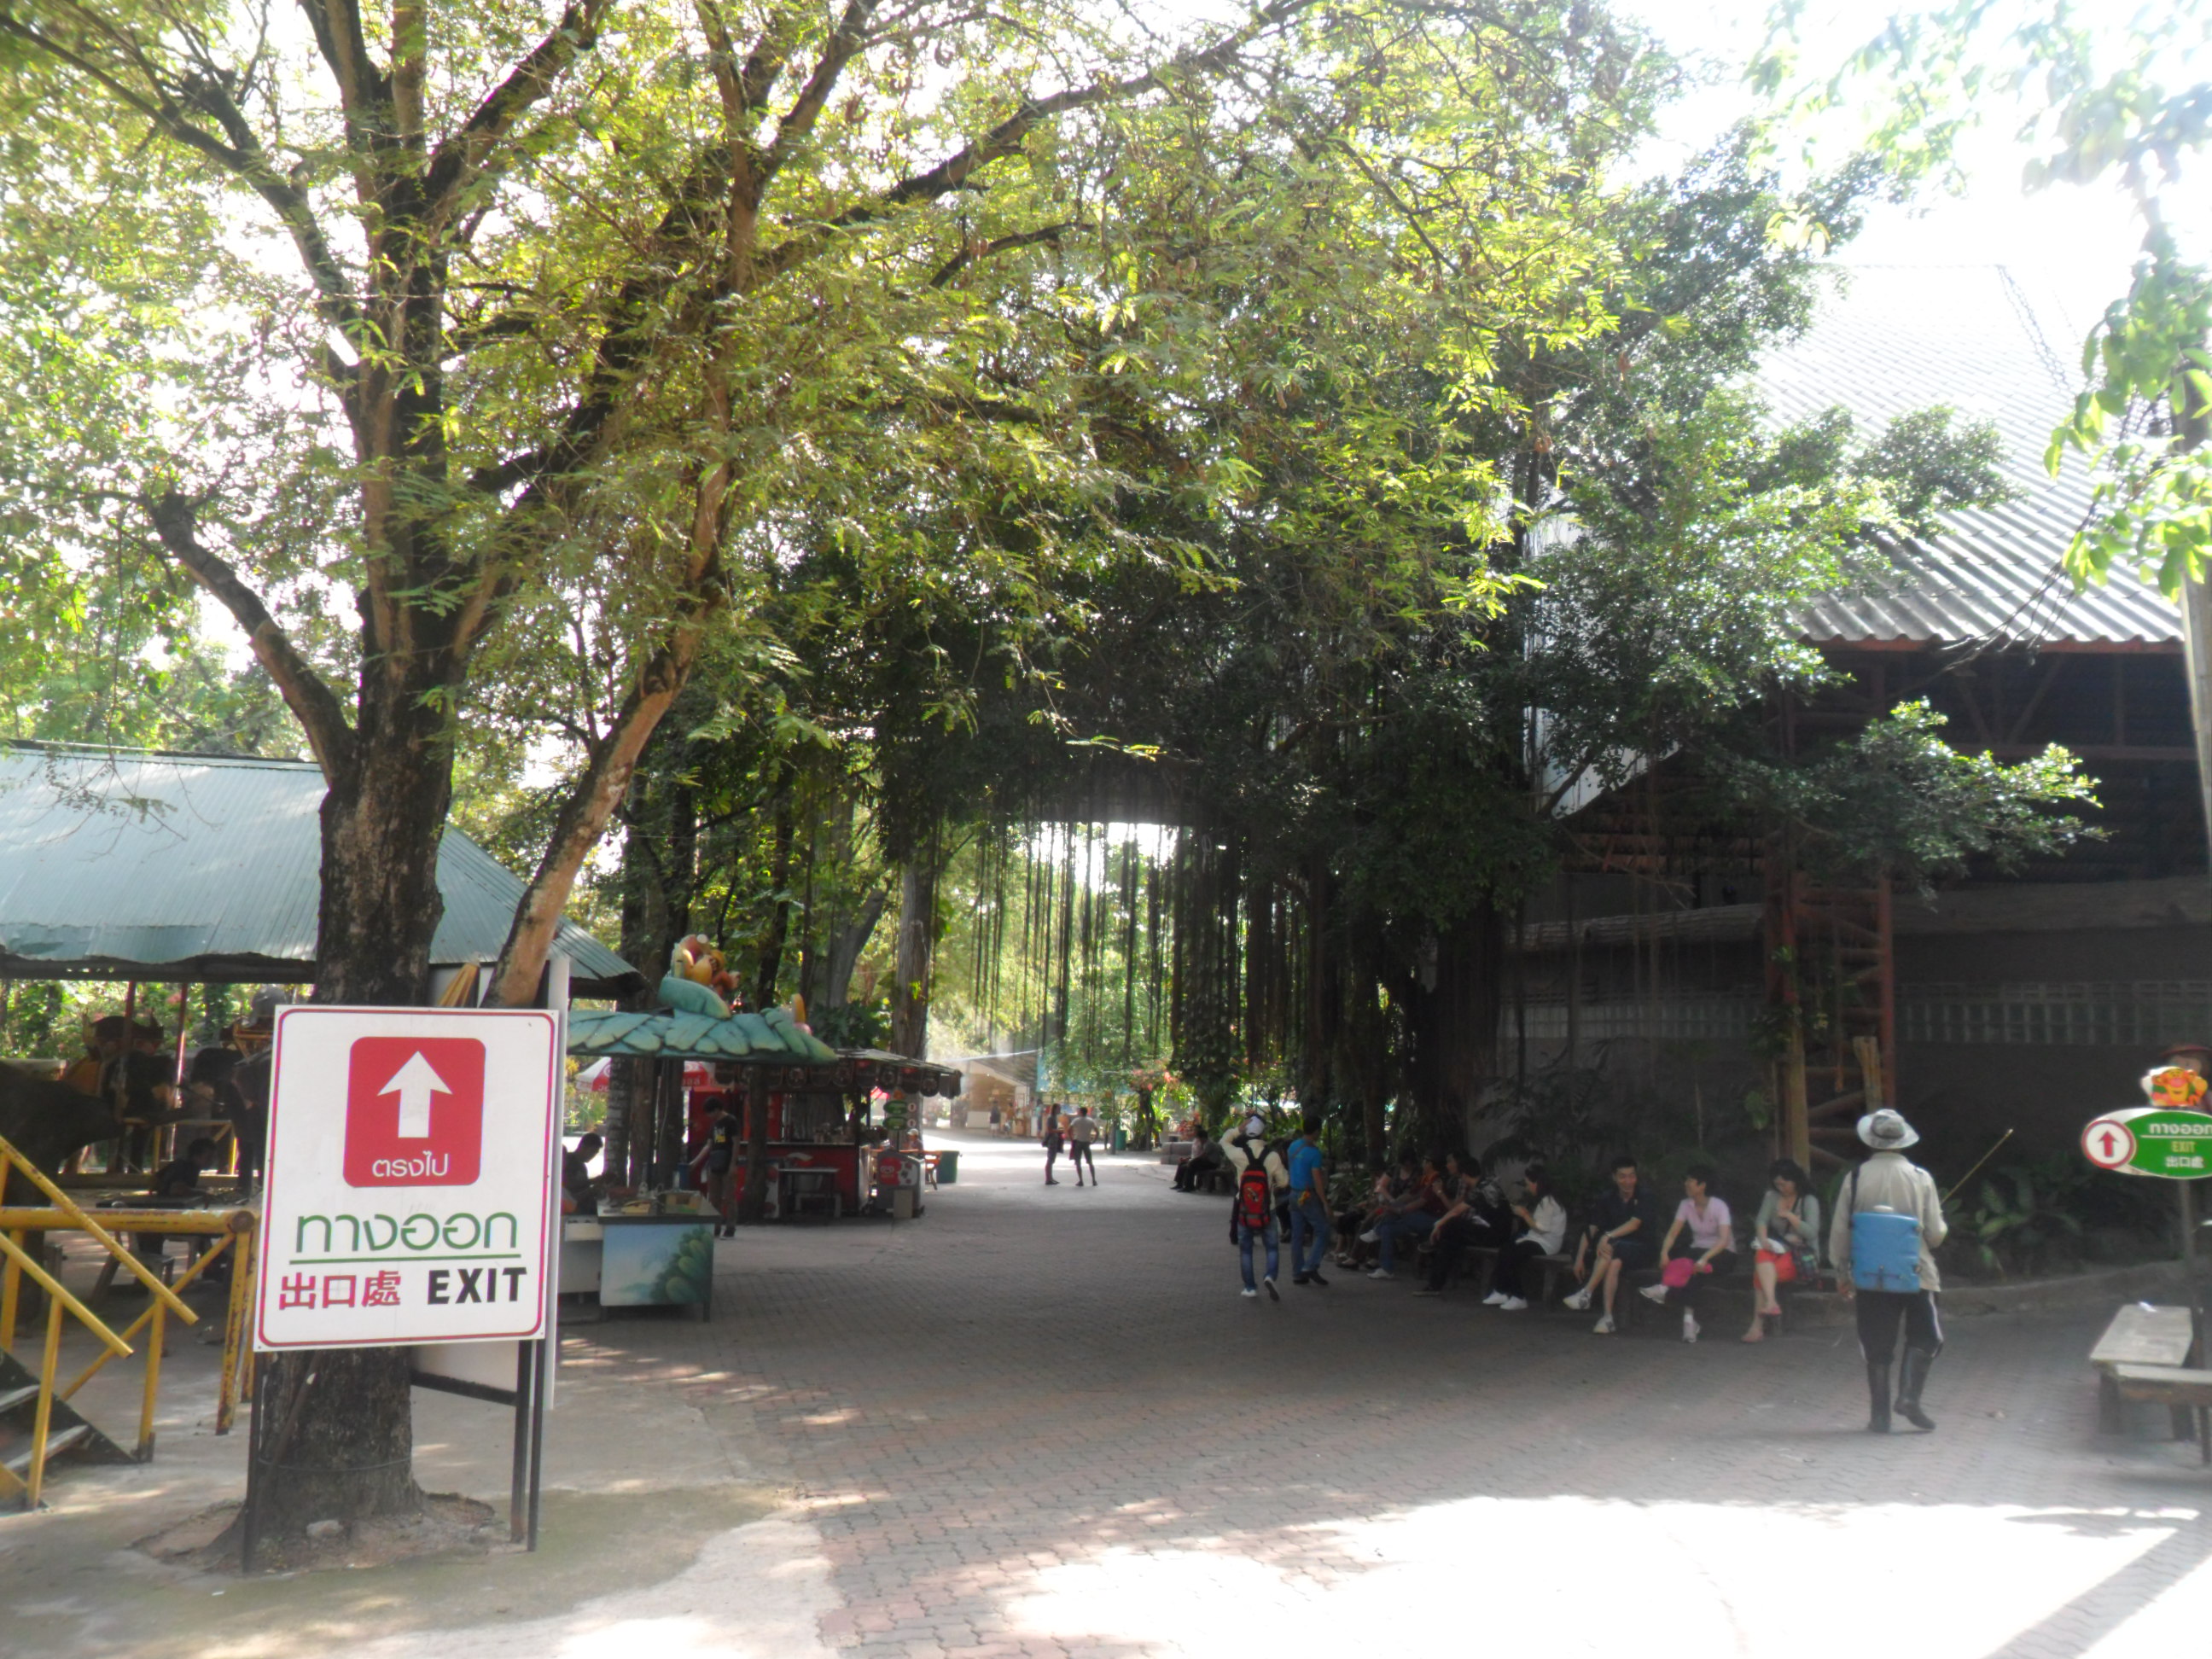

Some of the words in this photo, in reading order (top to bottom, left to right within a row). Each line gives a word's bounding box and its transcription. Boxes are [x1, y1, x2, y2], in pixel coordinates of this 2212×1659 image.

[372, 1150, 449, 1177] ตรงไป
[2172, 1141, 2196, 1153] EXIT
[296, 1212, 517, 1253] ทางออก
[278, 1270, 401, 1311] 出口處
[427, 1266, 527, 1305] EXIT
